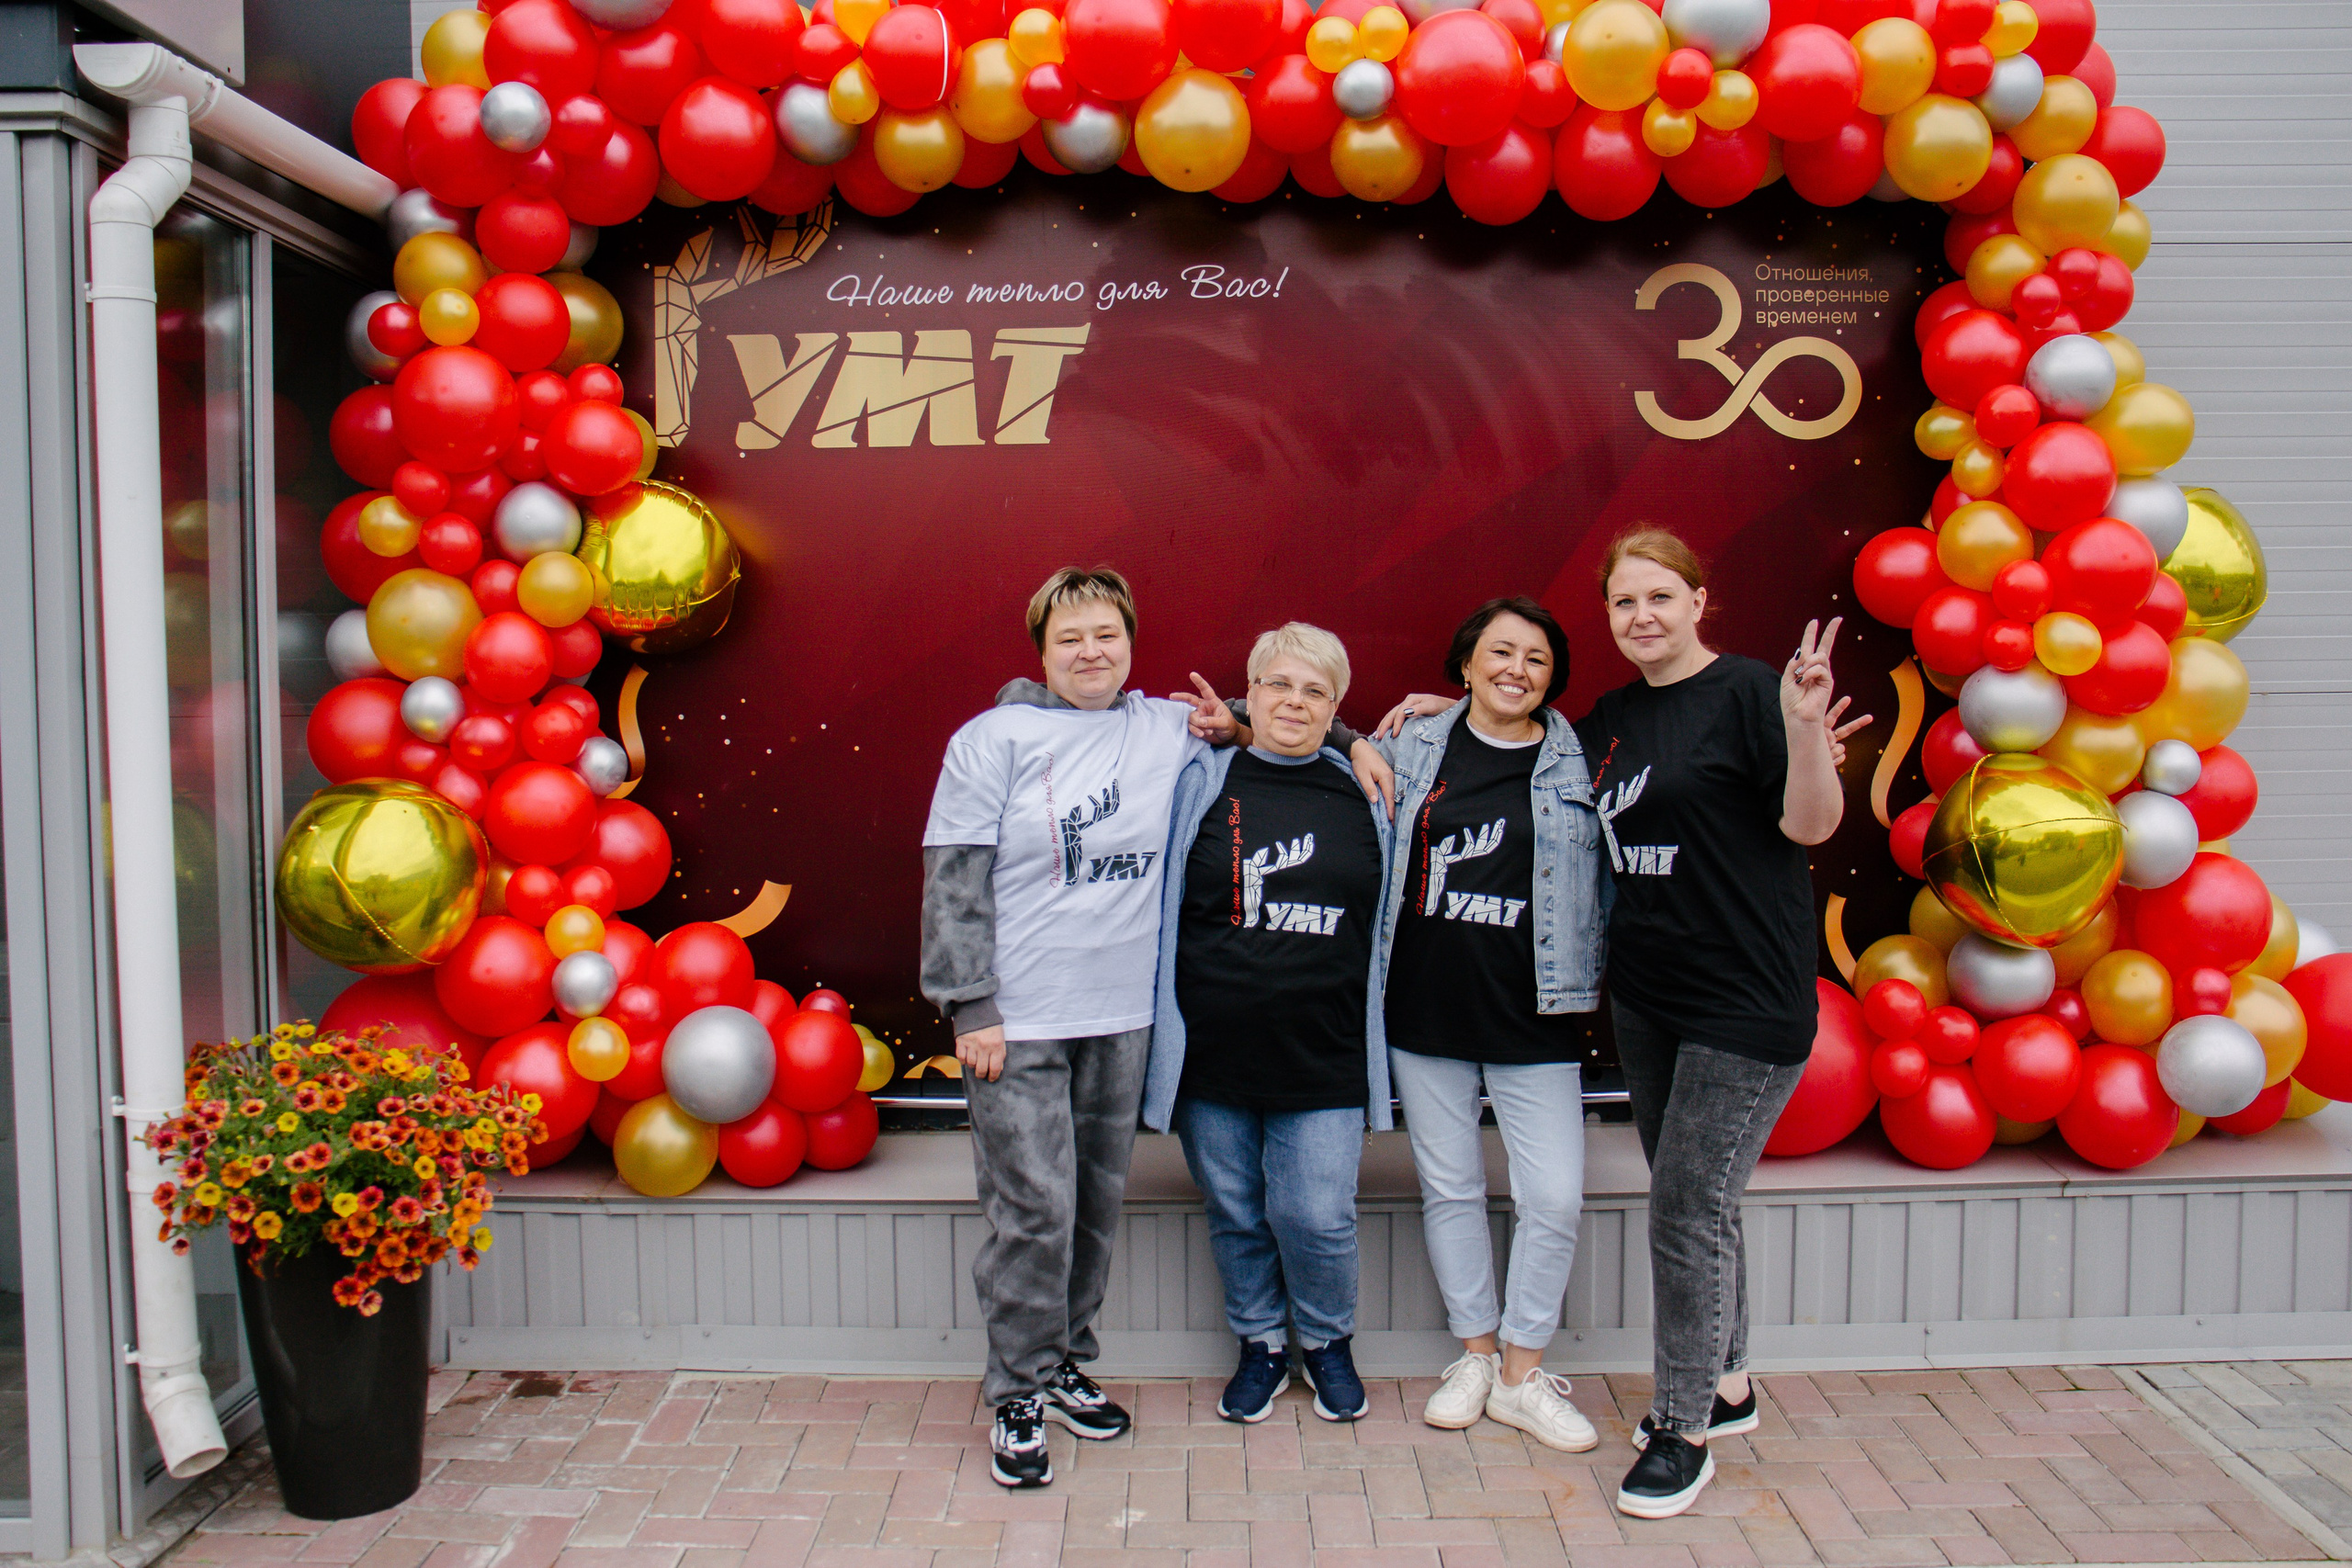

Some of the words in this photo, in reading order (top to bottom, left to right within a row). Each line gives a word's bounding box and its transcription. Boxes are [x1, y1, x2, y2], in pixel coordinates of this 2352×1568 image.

[1755, 264, 1873, 283] Отношения,
[826, 274, 954, 308] Наше
[967, 278, 1085, 304] тепло
[1096, 278, 1169, 310] для
[1180, 264, 1290, 300] Вас!
[1755, 288, 1890, 307] проверенные
[1755, 310, 1858, 328] временем
[1046, 785, 1057, 806] для
[1046, 807, 1058, 844] тепло
